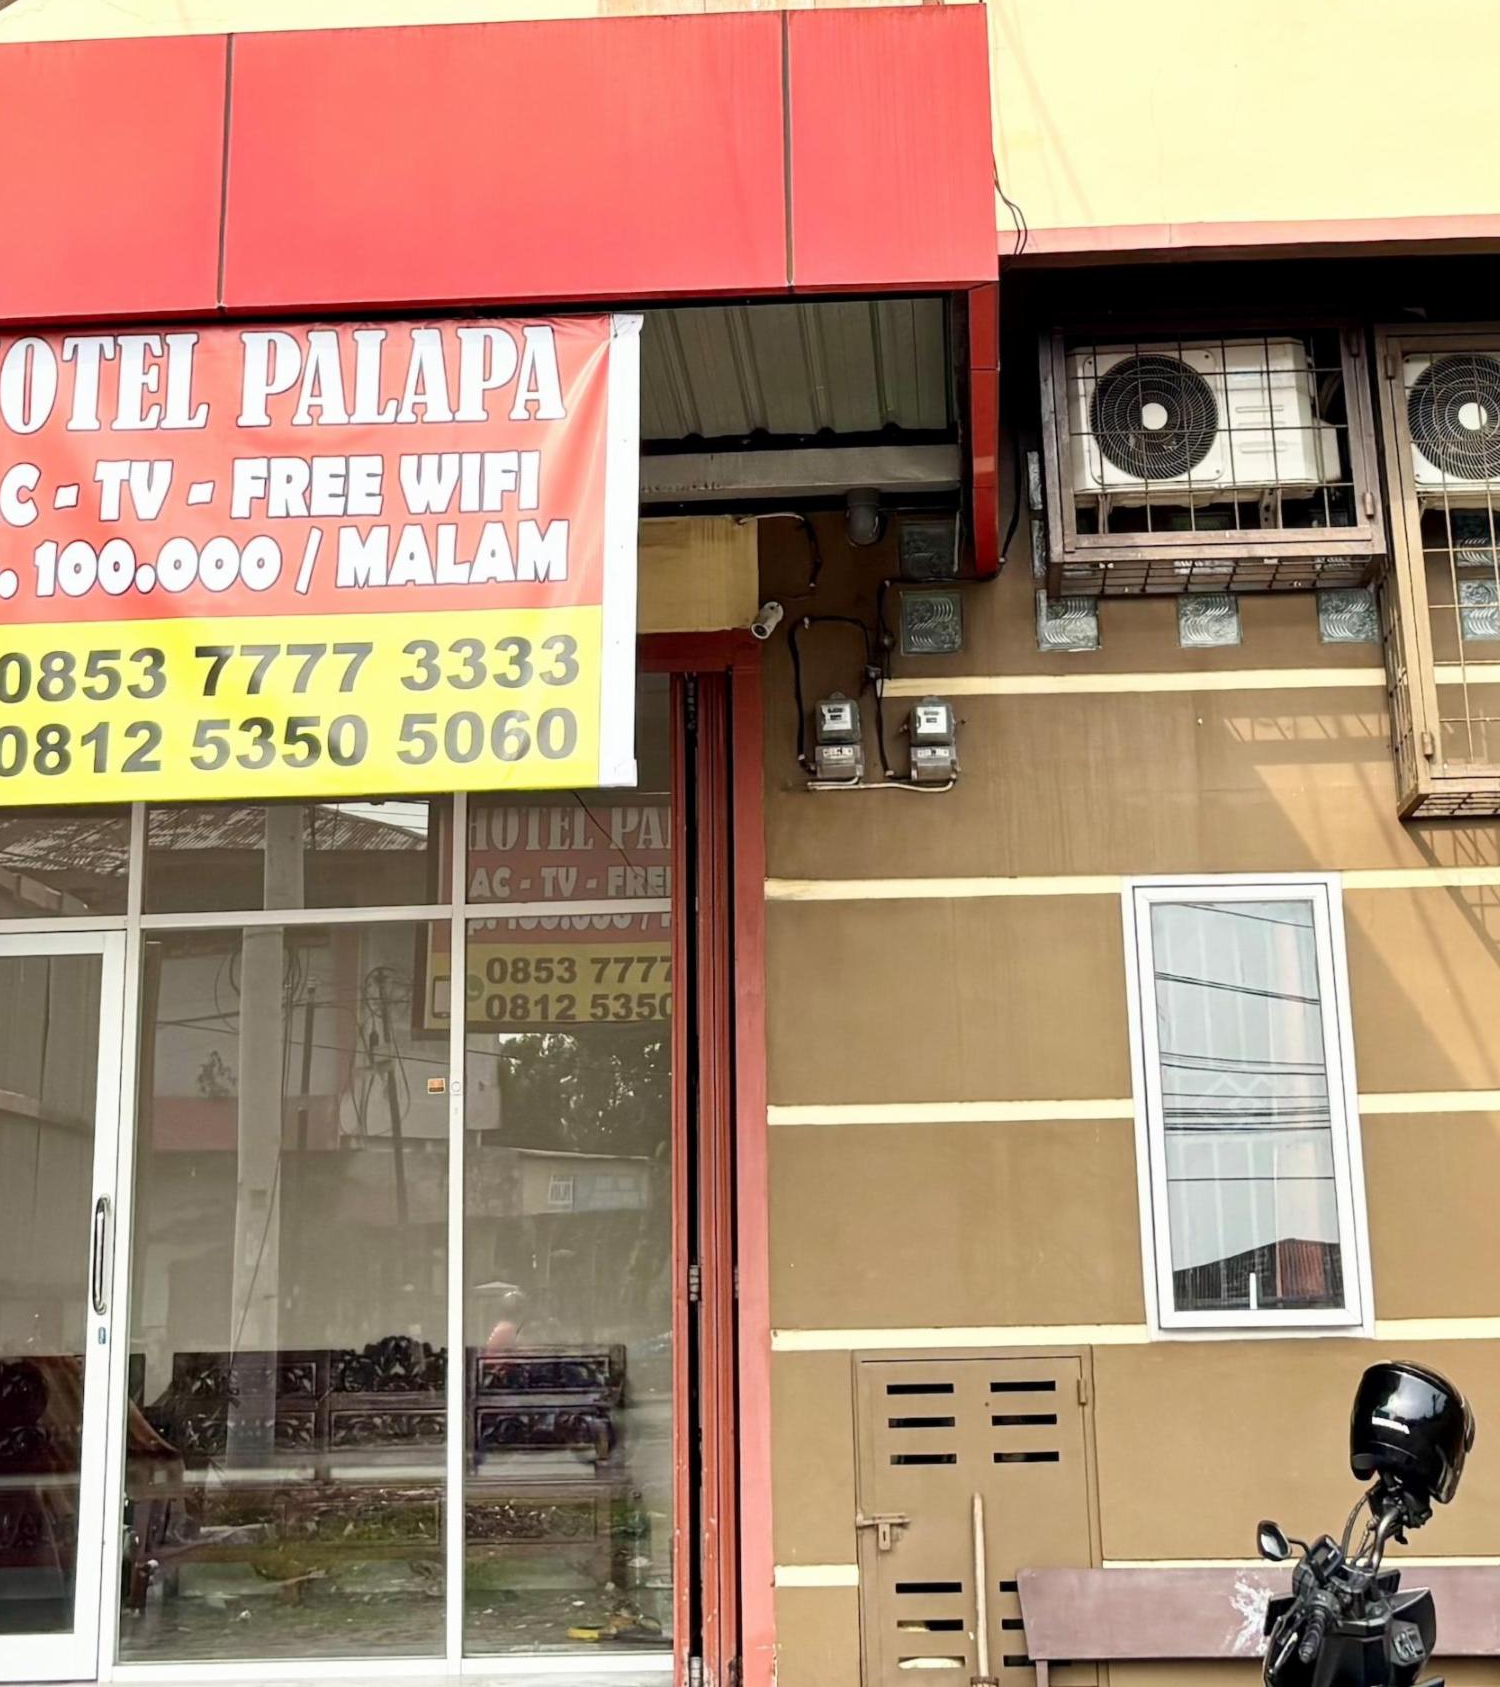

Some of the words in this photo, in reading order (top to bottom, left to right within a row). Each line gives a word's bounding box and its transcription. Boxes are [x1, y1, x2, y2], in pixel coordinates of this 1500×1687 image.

[236, 325, 567, 428] PALAPA
[53, 483, 79, 510] -
[93, 459, 173, 521] TV
[187, 480, 214, 506] -
[230, 454, 384, 520] FREE
[399, 449, 541, 514] WIFI
[34, 534, 283, 598] 100.000
[295, 526, 323, 595] /
[334, 519, 569, 589] MALAM
[194, 642, 374, 697] 7777
[400, 633, 580, 691] 3333
[189, 714, 368, 772] 5350
[396, 707, 578, 765] 5060
[469, 807, 595, 851] HOTEL
[609, 806, 671, 850] PA
[469, 866, 512, 898] AC
[541, 866, 578, 898] TV
[486, 957, 577, 984] 0853
[486, 994, 576, 1021] 0812
